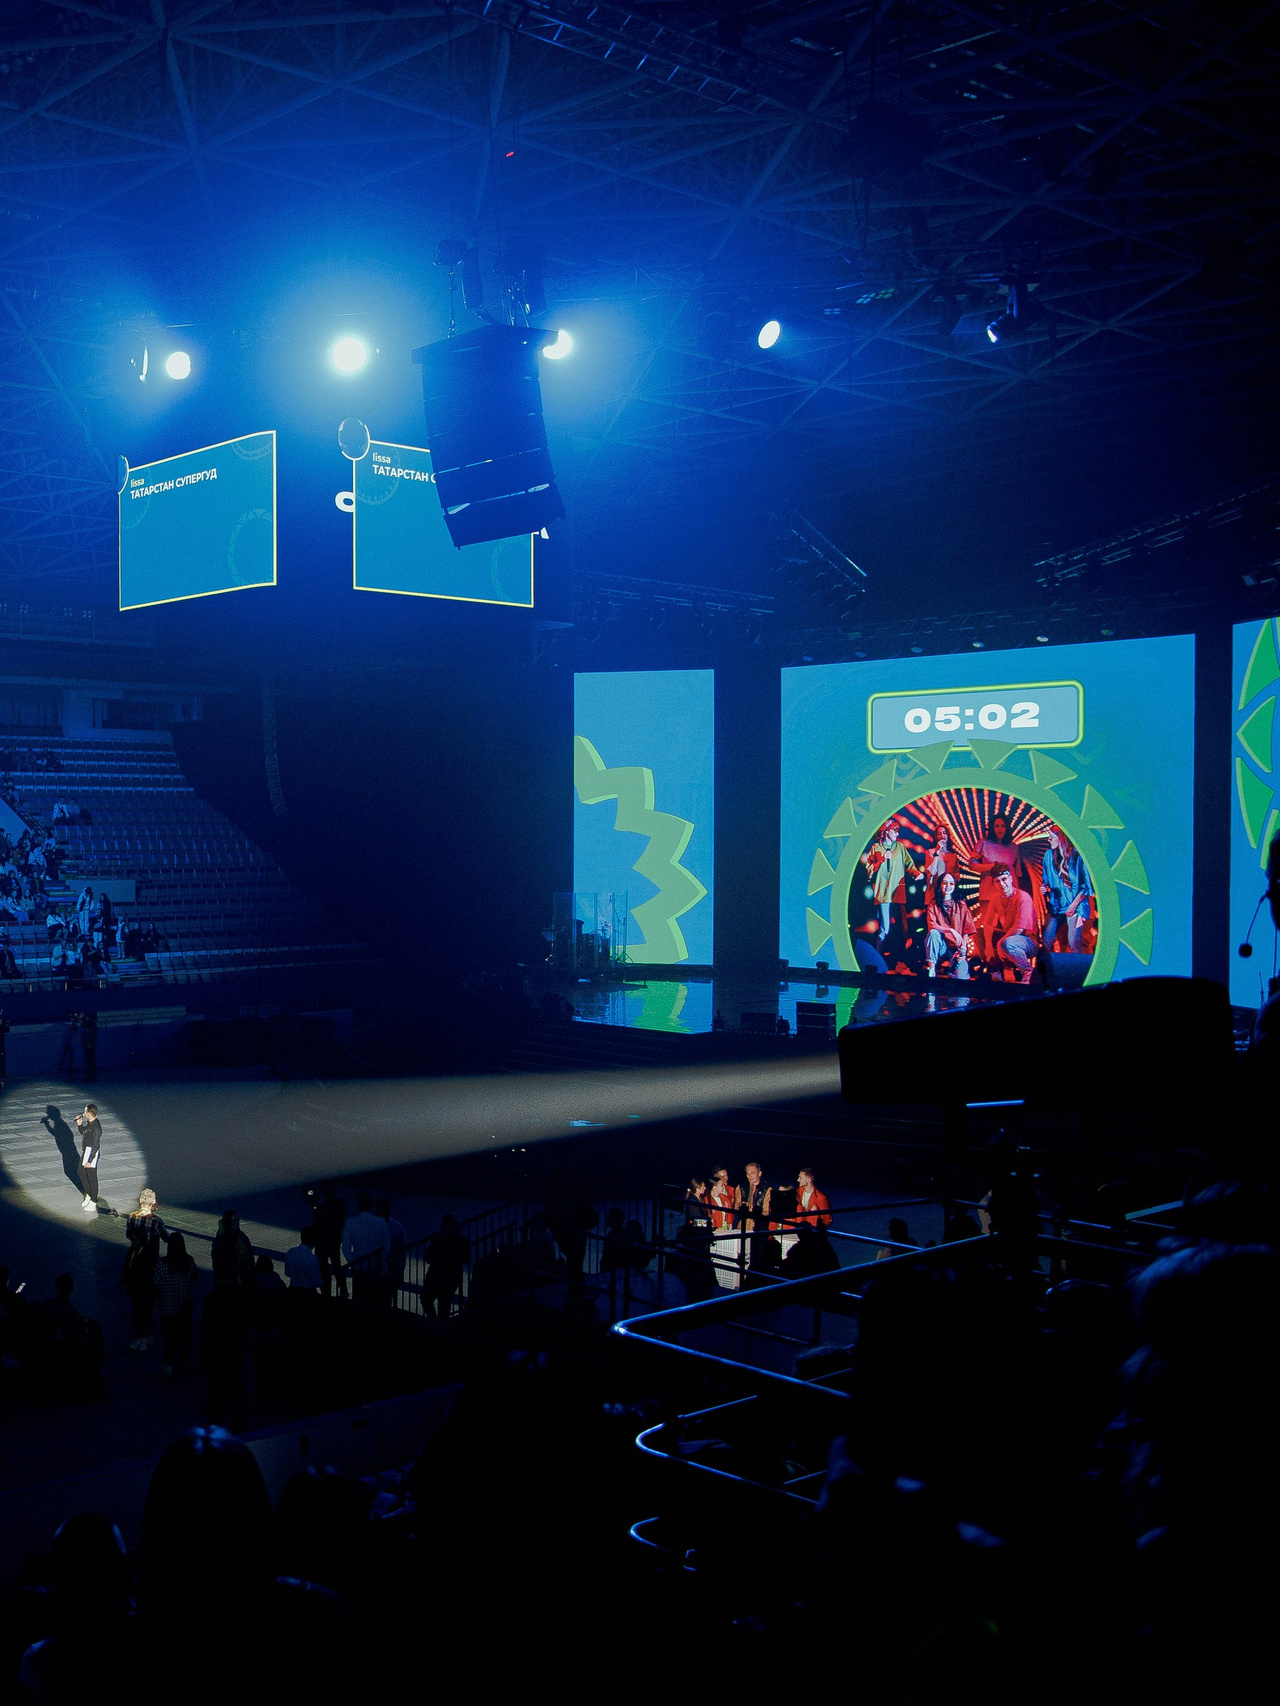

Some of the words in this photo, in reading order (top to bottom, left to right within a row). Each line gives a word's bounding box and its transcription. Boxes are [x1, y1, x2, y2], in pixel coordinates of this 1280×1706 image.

[130, 479, 175, 500] ТАТАРСТАН
[175, 468, 218, 488] СУПЕРГУД
[372, 464, 429, 483] ТАТАРСТАН
[904, 701, 1040, 733] 05:02
